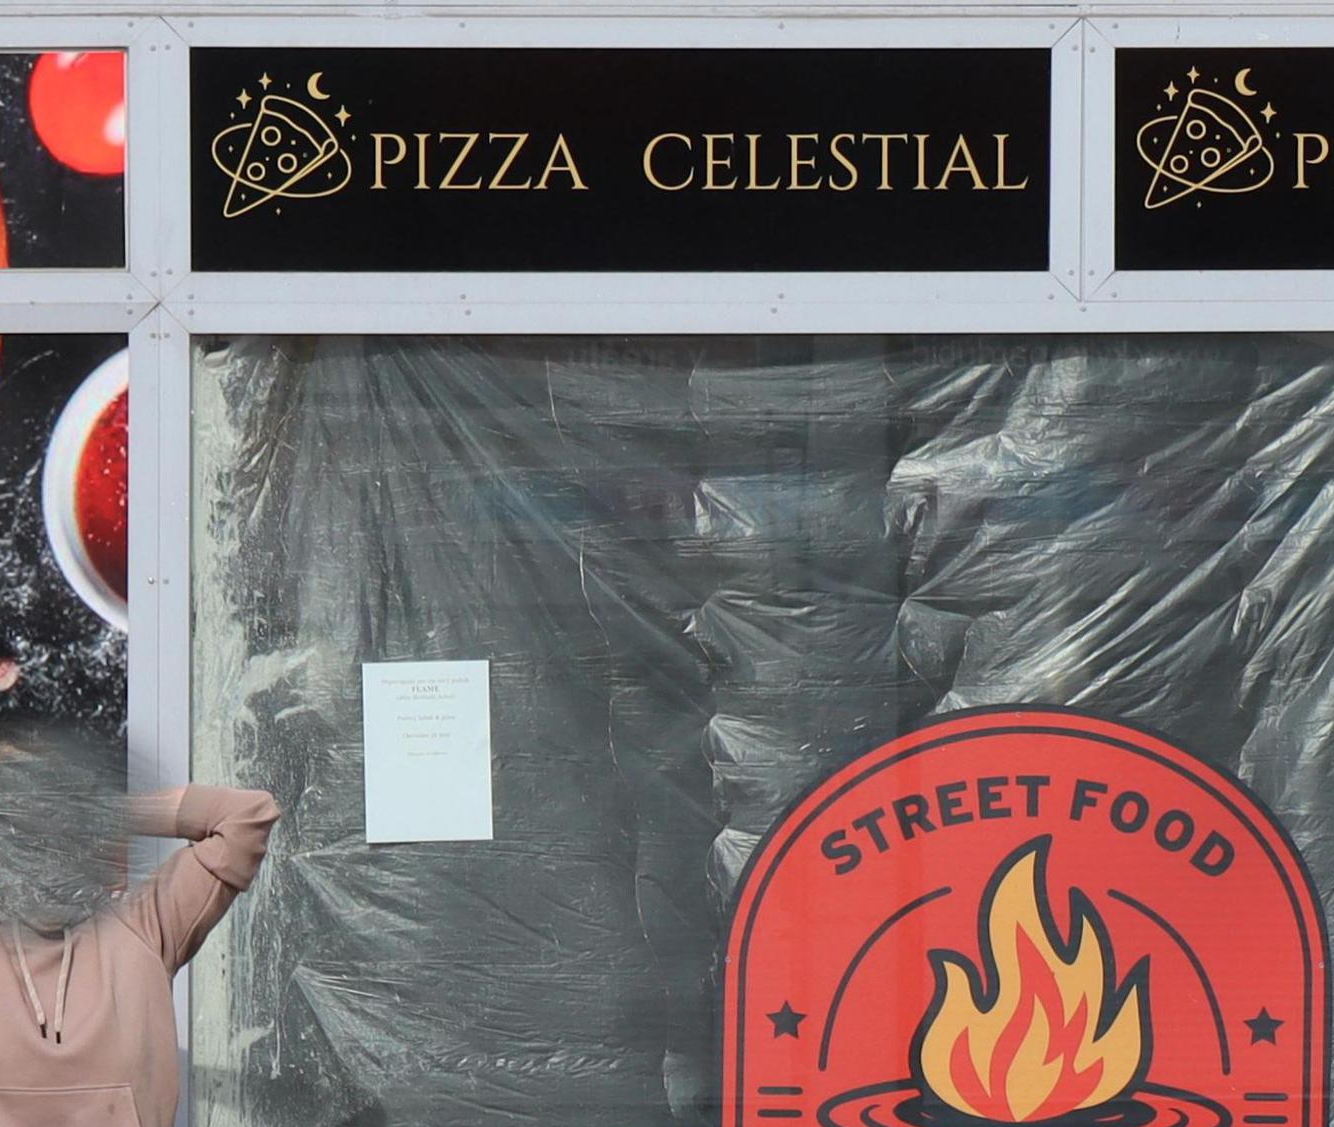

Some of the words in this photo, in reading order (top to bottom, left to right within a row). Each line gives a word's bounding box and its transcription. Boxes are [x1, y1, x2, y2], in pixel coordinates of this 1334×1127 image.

[370, 132, 589, 191] PIZZA
[643, 132, 1029, 192] CELESTIAL
[820, 774, 1051, 876] STREET
[1069, 779, 1237, 878] FOOD
